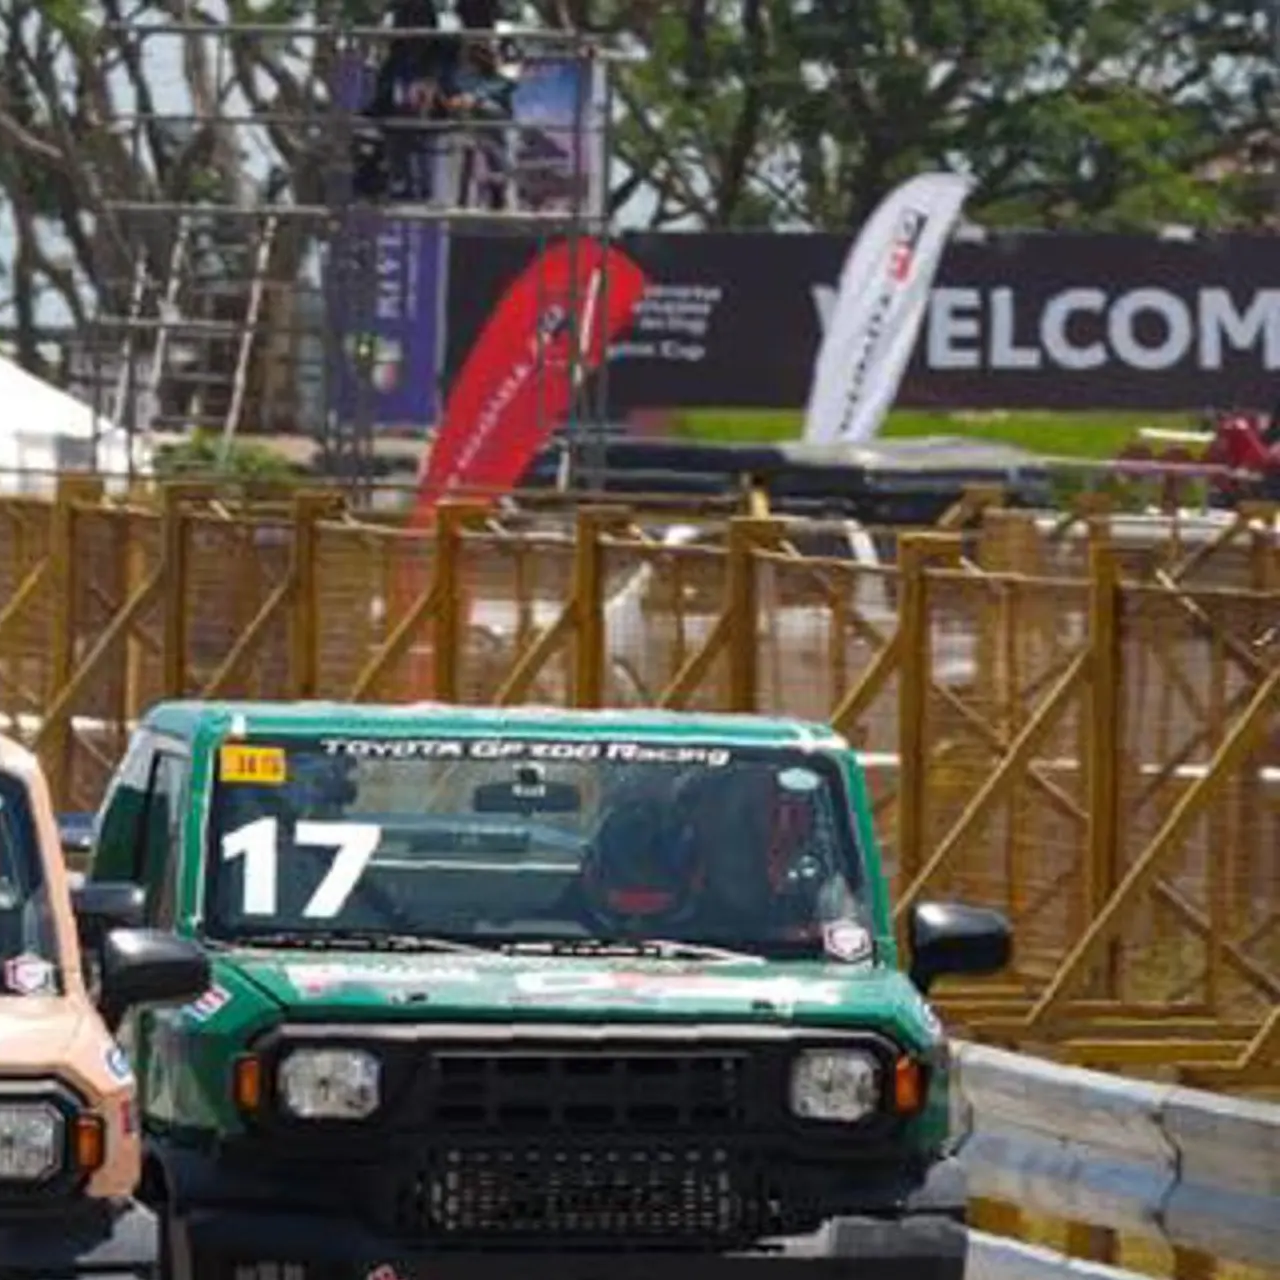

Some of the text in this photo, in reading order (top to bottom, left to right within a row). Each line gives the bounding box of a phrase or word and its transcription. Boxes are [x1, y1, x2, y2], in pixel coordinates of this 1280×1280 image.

[320, 739, 462, 760] TOYOTA
[607, 742, 731, 767] Racing
[220, 818, 383, 919] 17
